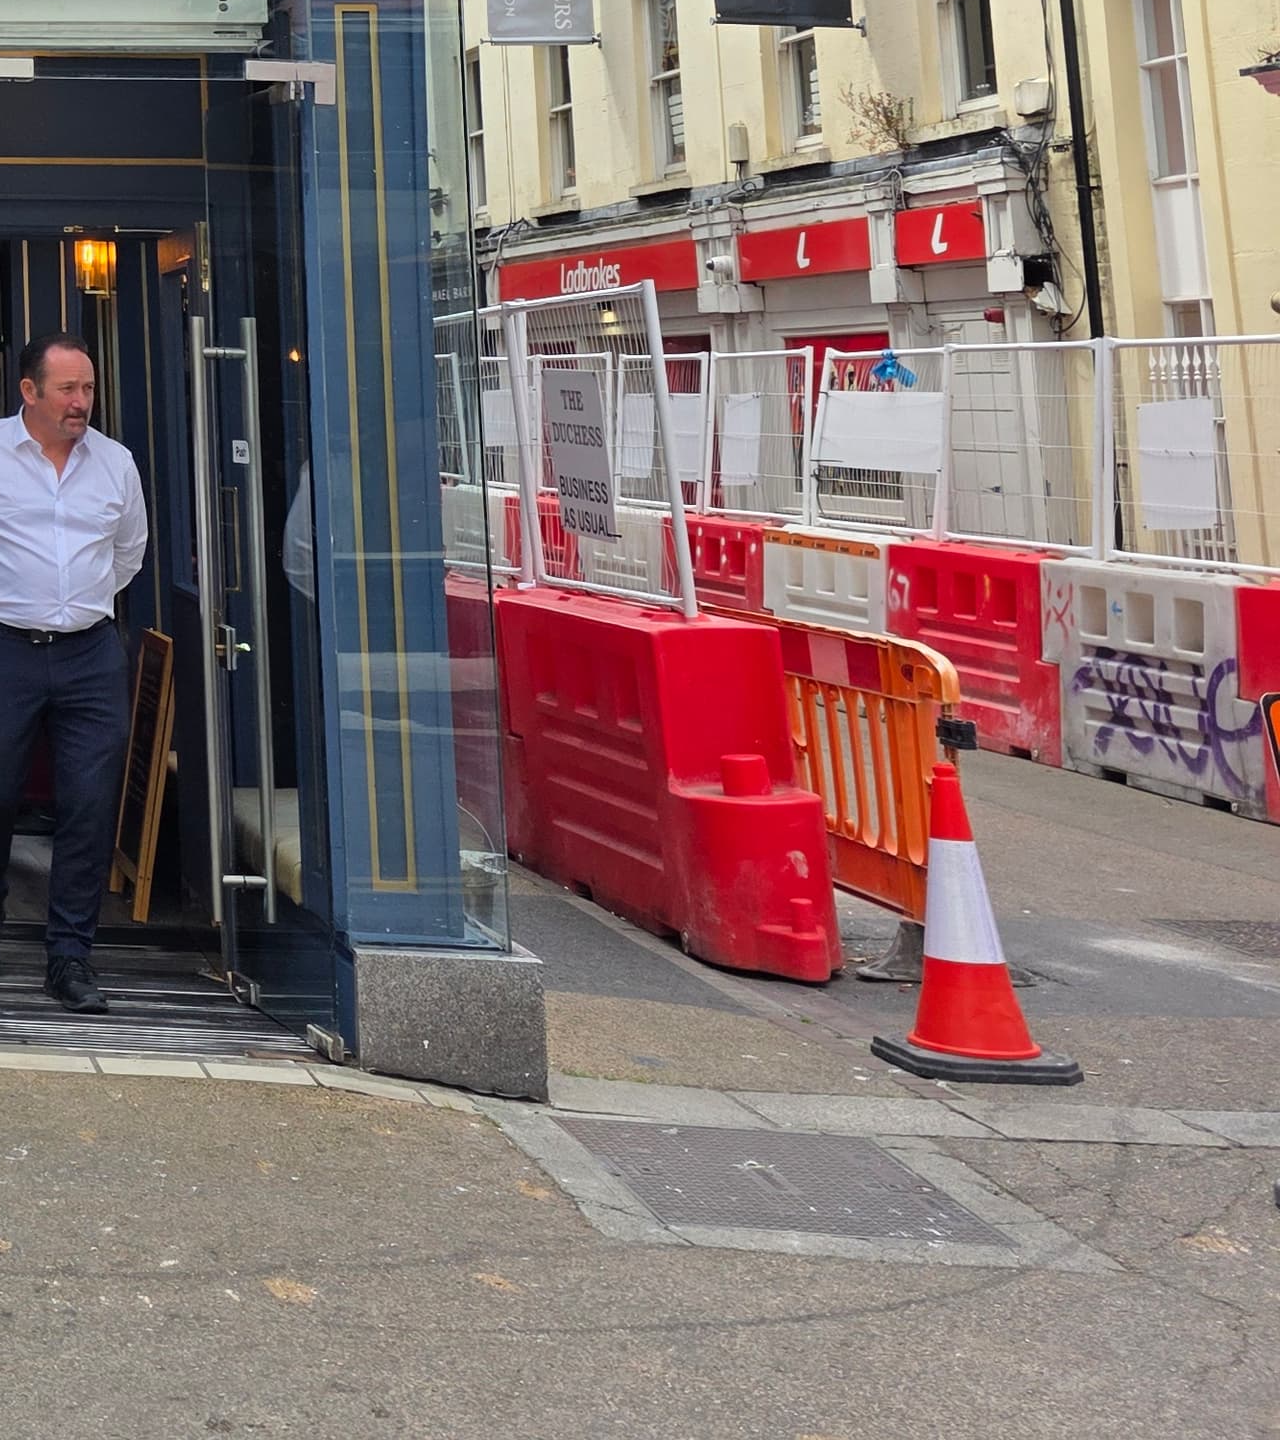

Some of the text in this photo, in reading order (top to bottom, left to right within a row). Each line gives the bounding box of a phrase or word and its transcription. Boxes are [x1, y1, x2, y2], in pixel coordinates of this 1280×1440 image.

[560, 257, 621, 294] Ladbrokes
[559, 388, 584, 411] THE
[552, 422, 603, 448] DUCHESS
[559, 475, 609, 505] BUSINESS
[564, 508, 611, 537] AS USUAL
